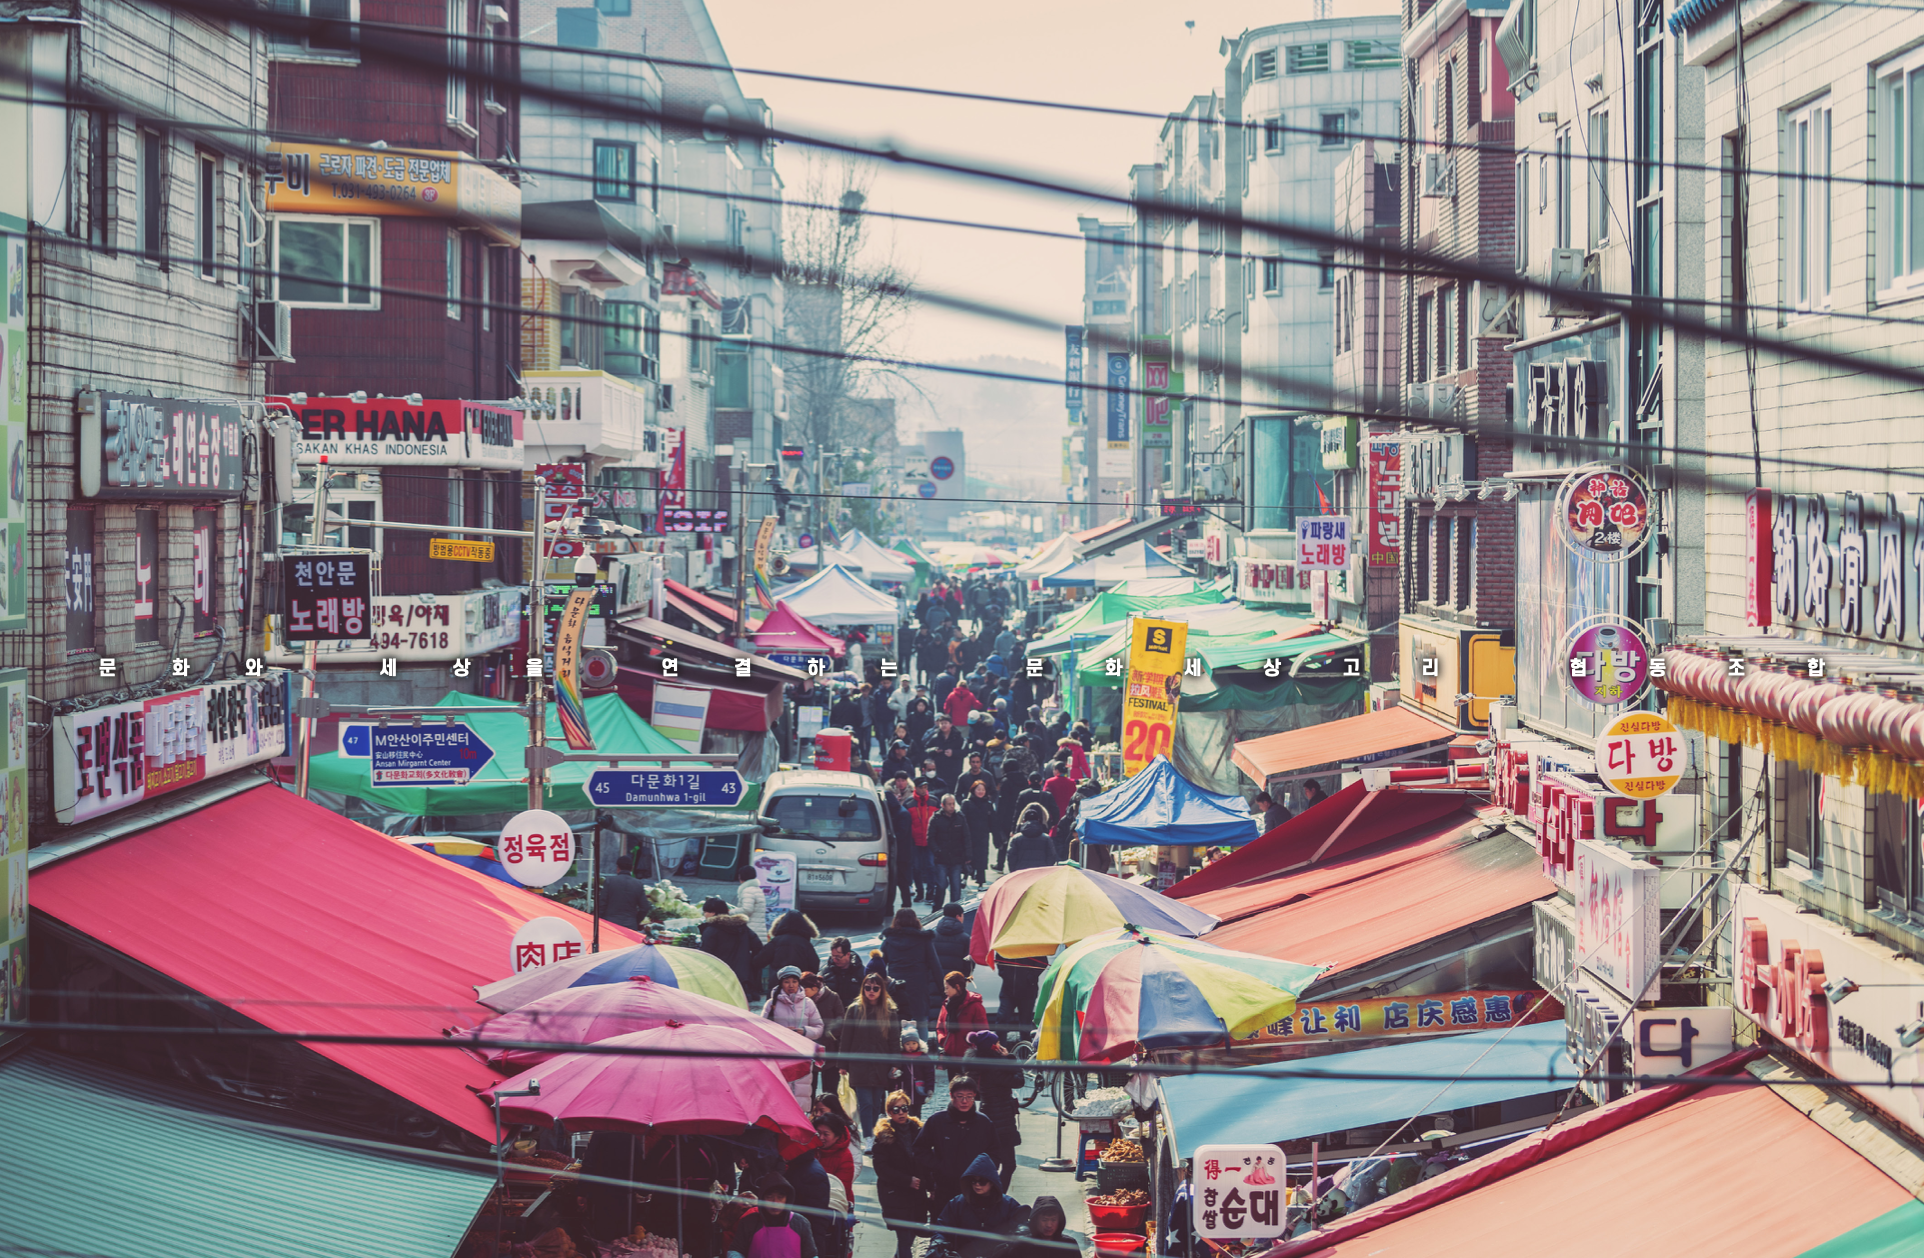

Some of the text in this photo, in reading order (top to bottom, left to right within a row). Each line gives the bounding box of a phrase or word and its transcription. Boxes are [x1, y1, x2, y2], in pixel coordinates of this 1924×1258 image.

[356, 410, 448, 442] HANA
[345, 443, 378, 455] KHAS
[385, 444, 448, 456] INDONESIA
[1310, 521, 1346, 540] 파랑새
[1301, 543, 1347, 566] 노래방
[295, 561, 356, 587] 천안문
[289, 596, 366, 635] 노래방
[370, 632, 449, 650] 494-7618
[560, 597, 586, 679] 다문화 음식거리
[1594, 685, 1623, 698] 지하
[1128, 697, 1169, 712] FESTIVAL
[347, 736, 359, 744] 47
[429, 759, 452, 767] Center
[459, 748, 477, 760] 10m
[1607, 736, 1678, 775] 다방
[595, 782, 610, 794] 45
[721, 782, 736, 794] 43
[626, 792, 707, 805] Damunhwa 1-gil
[504, 833, 570, 864] 정육점
[1246, 995, 1513, 1040] 峰让利 店庆感惠
[1203, 1159, 1242, 1181] 得一
[1202, 1187, 1219, 1230] 찹쌀
[1219, 1186, 1279, 1230] 순대
